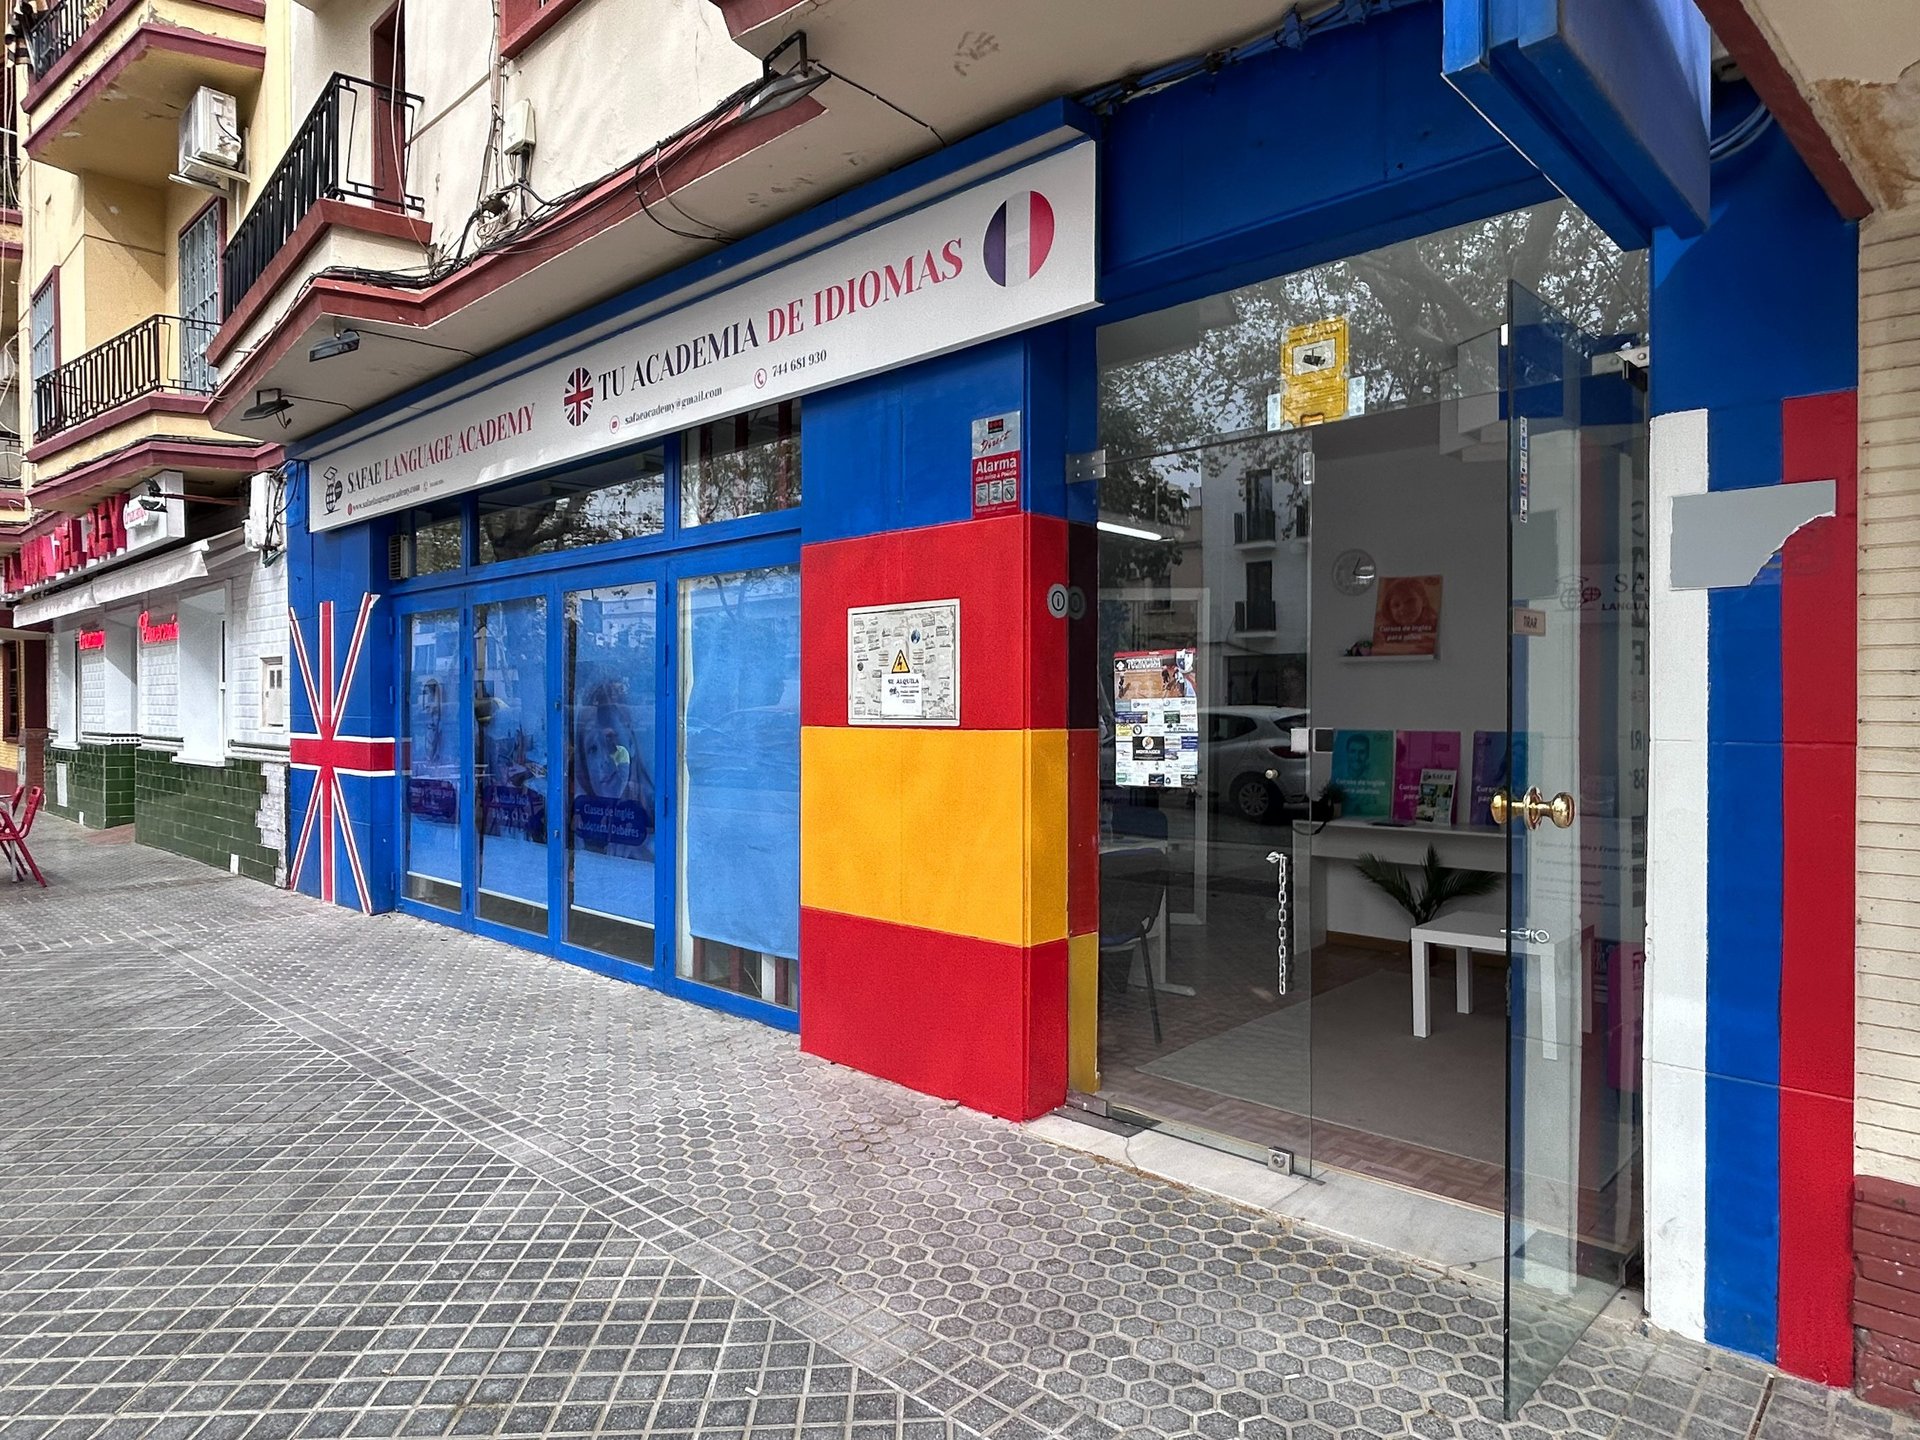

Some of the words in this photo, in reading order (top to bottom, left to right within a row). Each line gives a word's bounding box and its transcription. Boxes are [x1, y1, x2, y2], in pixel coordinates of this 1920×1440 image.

[598, 369, 626, 401] TU
[630, 317, 759, 391] ACADEMIA
[767, 299, 805, 343] DE
[813, 238, 964, 327] IDIOMAS
[624, 385, 723, 426] safaeacademy@gmail.com
[771, 361, 789, 379] 744
[790, 356, 807, 374] 681
[808, 350, 828, 369] 930
[347, 461, 382, 494] SAFAE
[383, 434, 453, 481] LANGUAGE
[456, 402, 536, 456] ACADEMY
[976, 457, 1017, 474] Alarma
[981, 429, 1012, 453] Direct
